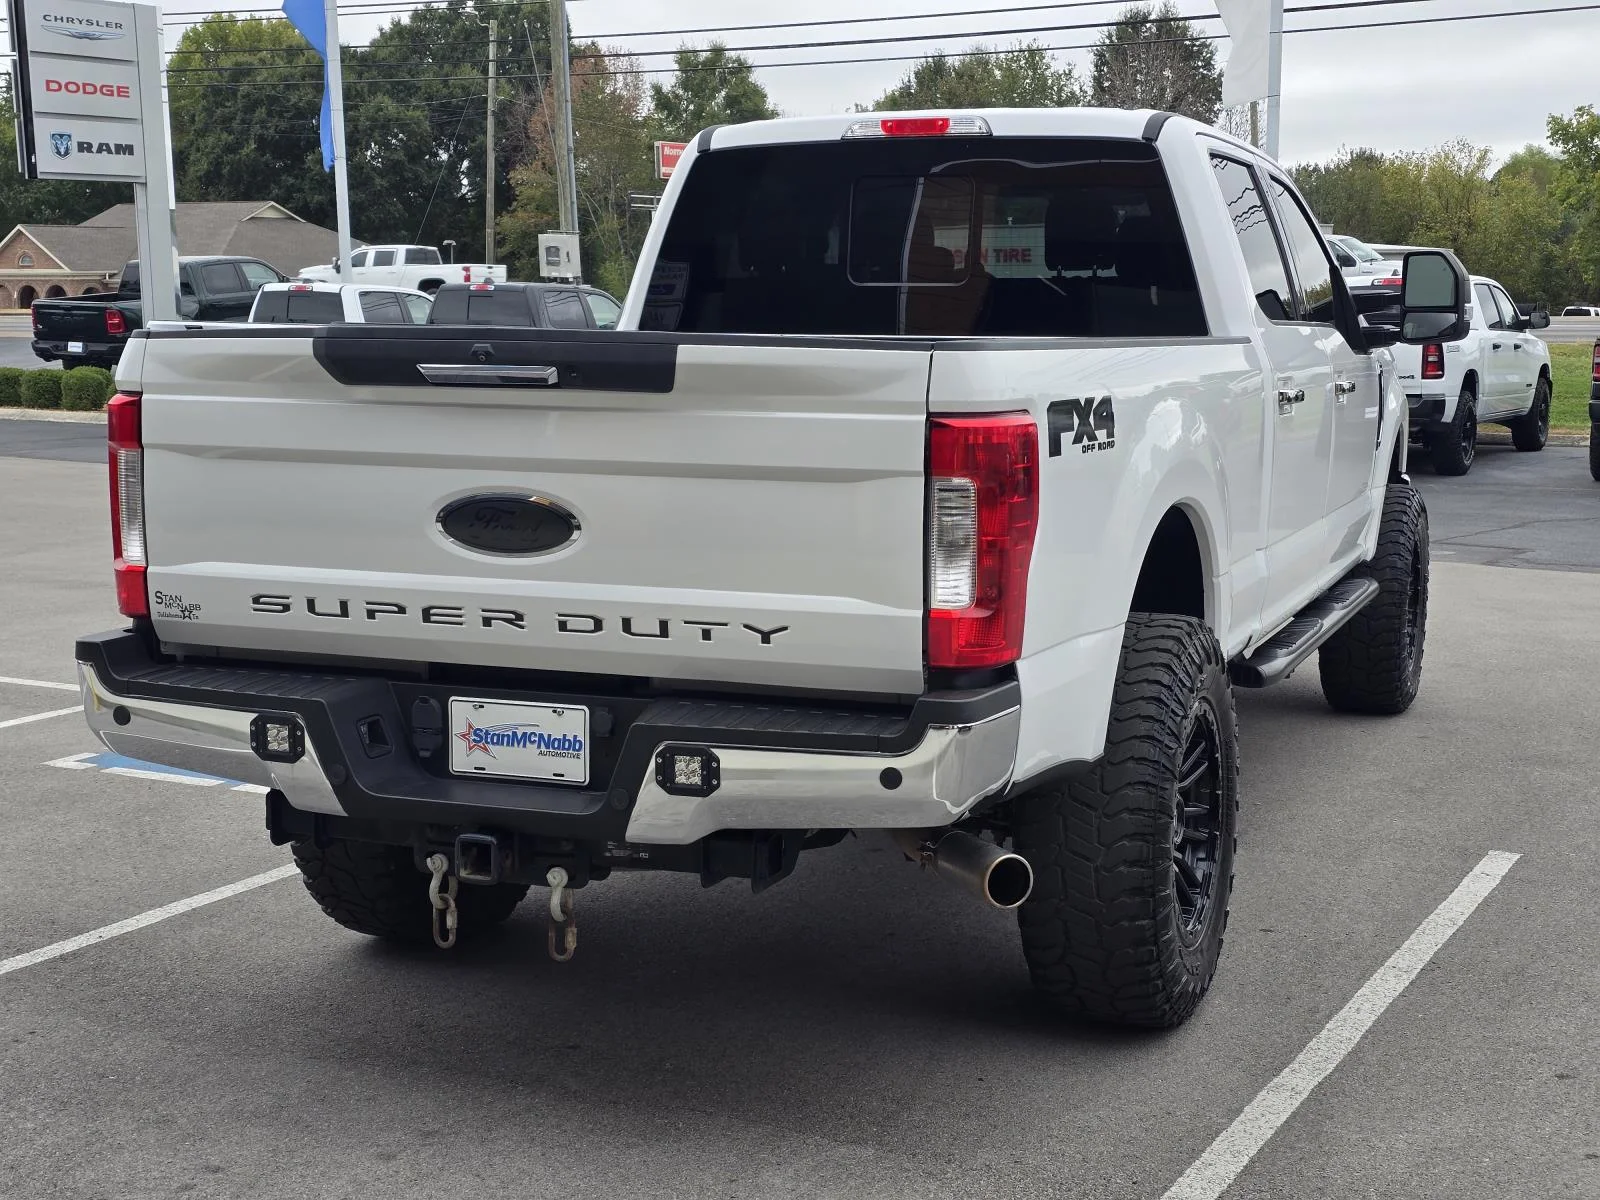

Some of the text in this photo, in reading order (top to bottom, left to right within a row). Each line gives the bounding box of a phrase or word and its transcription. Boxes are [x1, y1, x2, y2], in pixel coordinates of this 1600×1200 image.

[43, 14, 123, 30] CHRYSLER
[45, 79, 130, 98] DODGE
[77, 141, 134, 156] RAM
[992, 248, 1032, 264] TIRE
[1046, 395, 1115, 458] FX4
[1081, 440, 1115, 454] OFF ROAD
[250, 593, 791, 646] SUPER DUTY
[538, 749, 582, 759] AUTOMOTIVE
